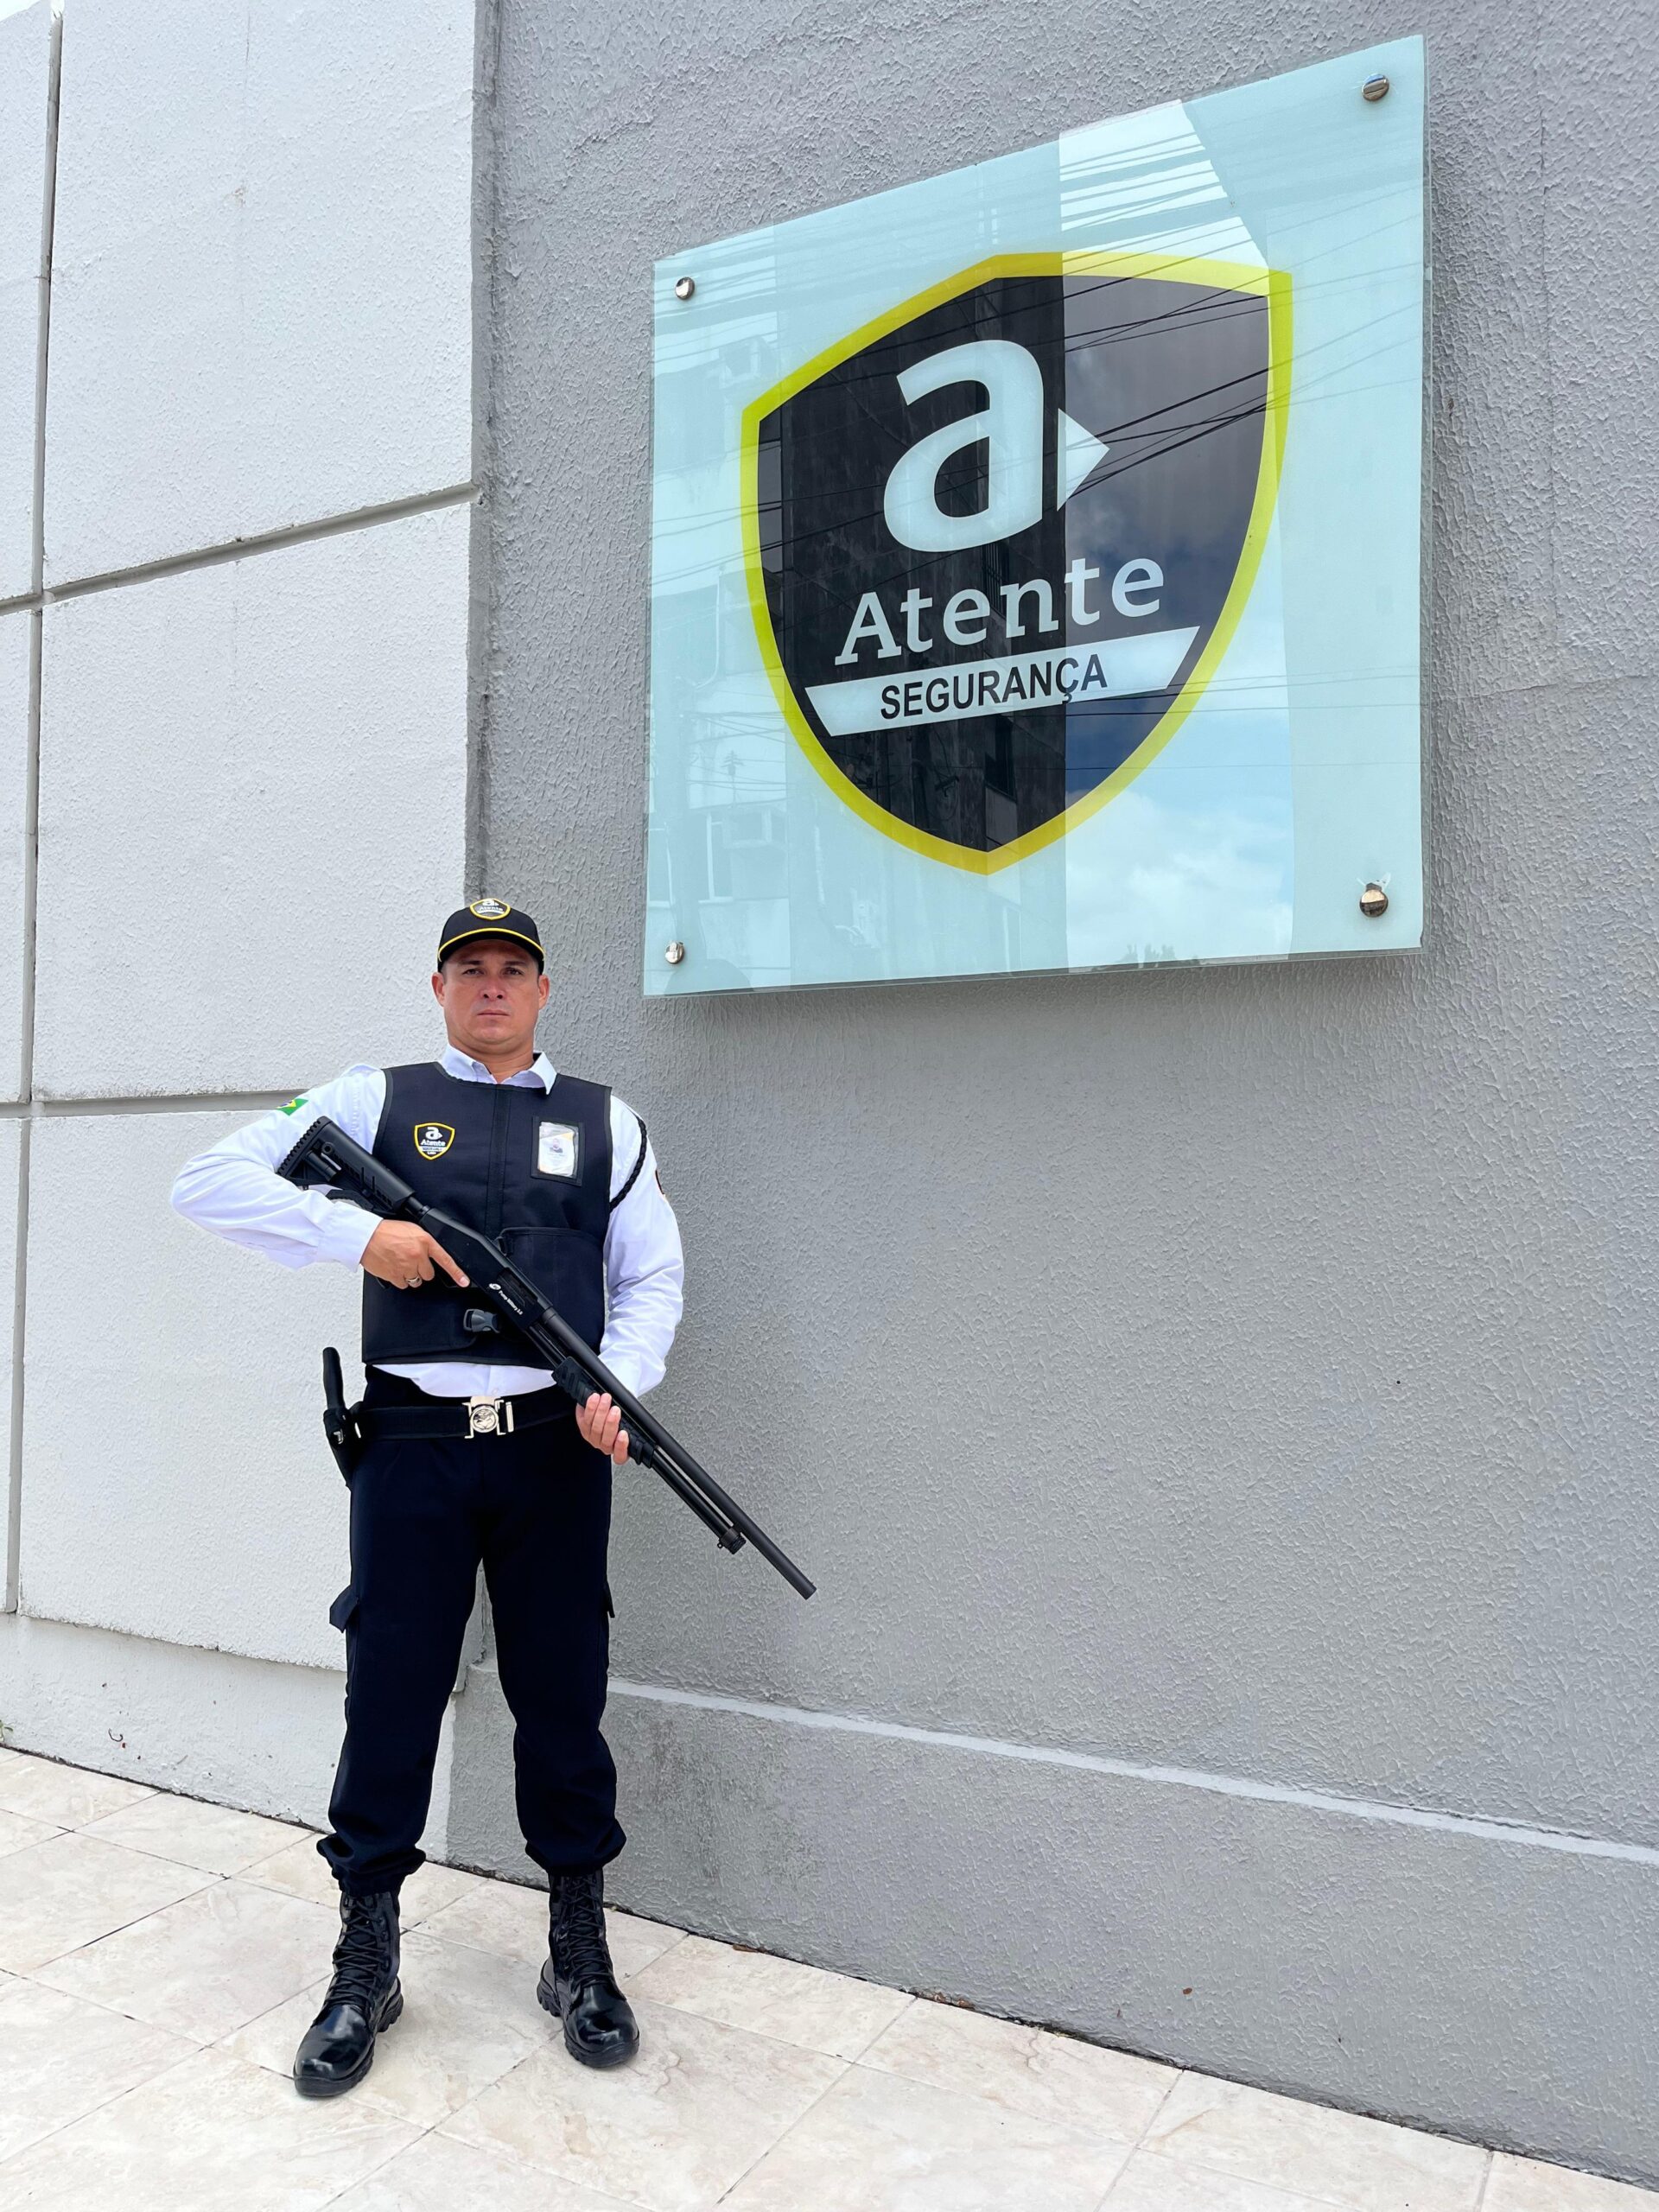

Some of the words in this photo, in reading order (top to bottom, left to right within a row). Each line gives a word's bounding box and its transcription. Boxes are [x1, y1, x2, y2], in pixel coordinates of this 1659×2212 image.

[884, 340, 1044, 552] a
[835, 557, 1165, 665] Atente
[880, 654, 1108, 719] SEGURANÇA
